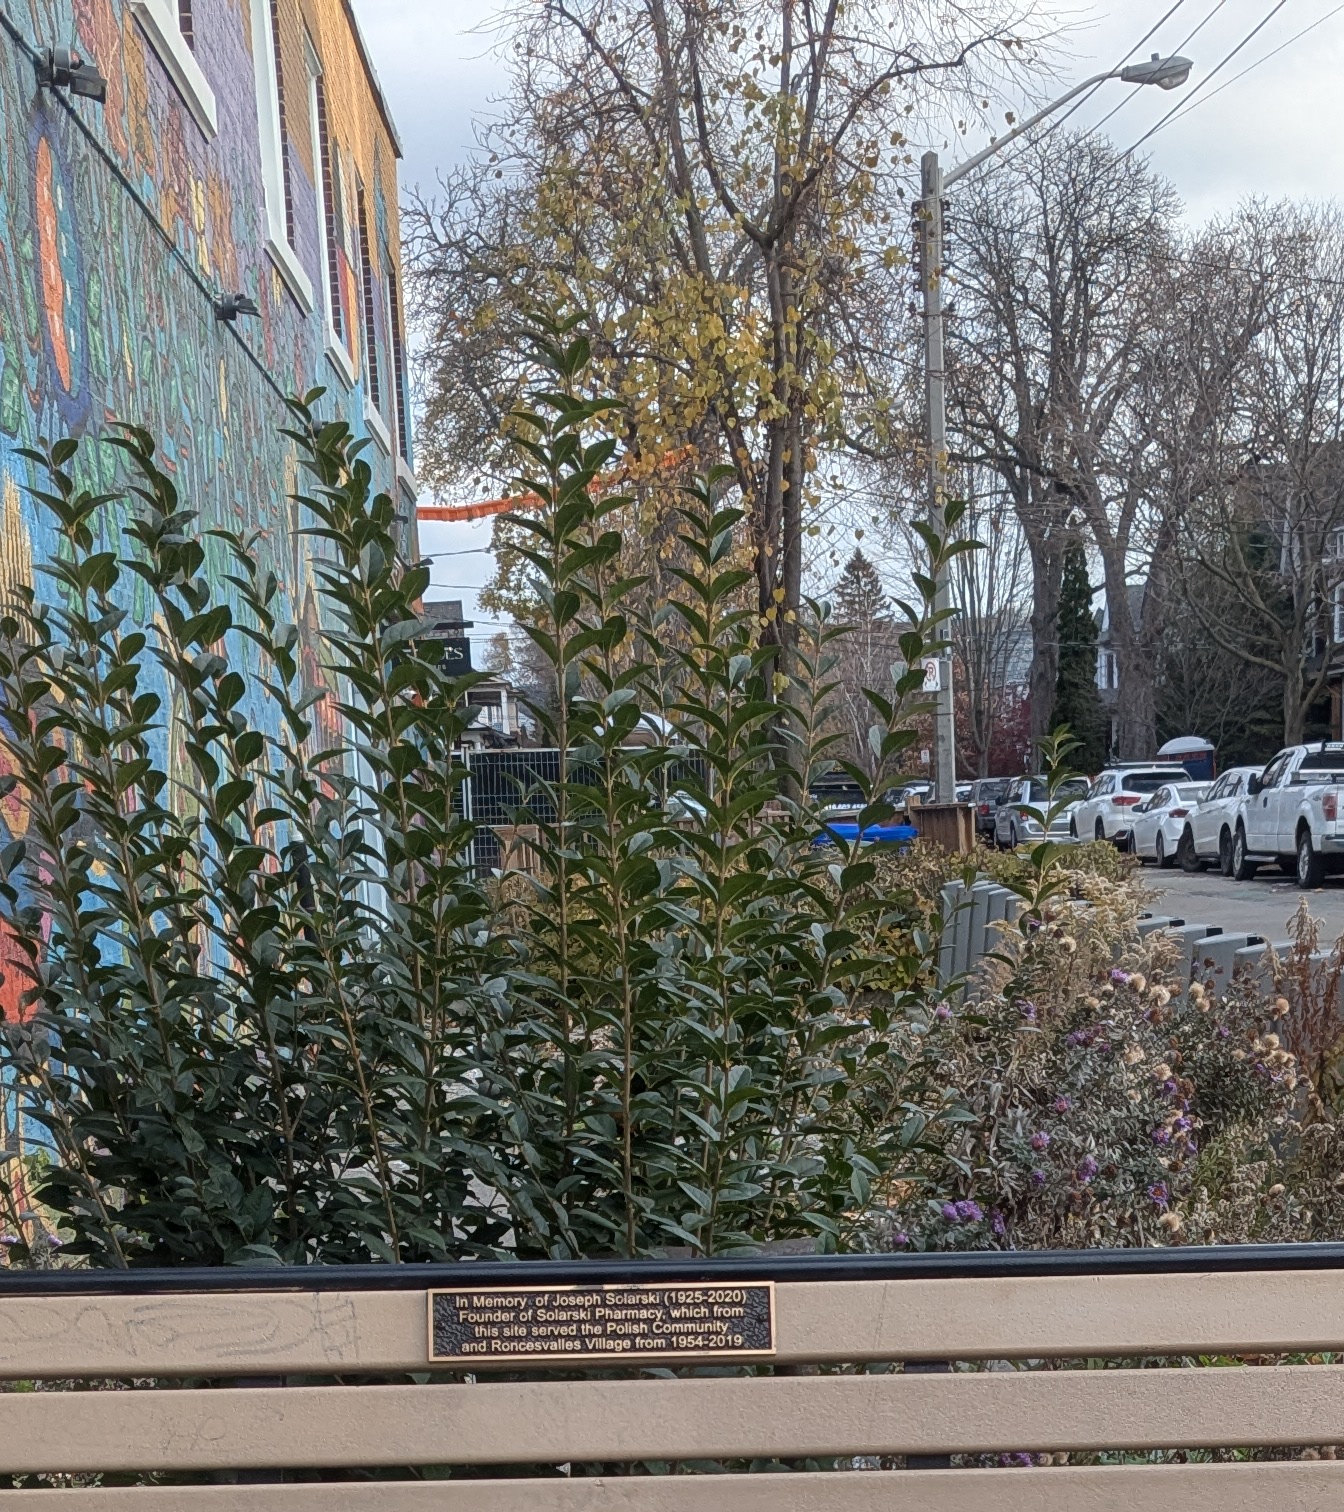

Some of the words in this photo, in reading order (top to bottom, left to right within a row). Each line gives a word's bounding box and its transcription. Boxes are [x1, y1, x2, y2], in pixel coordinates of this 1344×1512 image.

[456, 1296, 468, 1307] In
[473, 1294, 528, 1309] Memory
[535, 1294, 549, 1306] of
[553, 1293, 602, 1308] Joseph
[605, 1291, 660, 1305] Solarski
[664, 1289, 747, 1306] (1925-2020)
[459, 1310, 516, 1323] Founder
[519, 1309, 533, 1321] of
[536, 1308, 591, 1321] Solarski
[595, 1307, 666, 1321] Pharmacy,
[670, 1305, 709, 1318] which
[713, 1304, 744, 1317] from
[474, 1325, 499, 1337] this
[502, 1324, 527, 1337] site
[531, 1323, 577, 1336] served
[580, 1323, 603, 1335] the
[606, 1321, 648, 1334] Polish
[652, 1319, 729, 1334] Community
[461, 1340, 487, 1352] and
[491, 1337, 582, 1352] Roncesvalles
[585, 1336, 631, 1351] Village
[635, 1335, 666, 1348] from
[671, 1333, 743, 1347] 1954-2019
